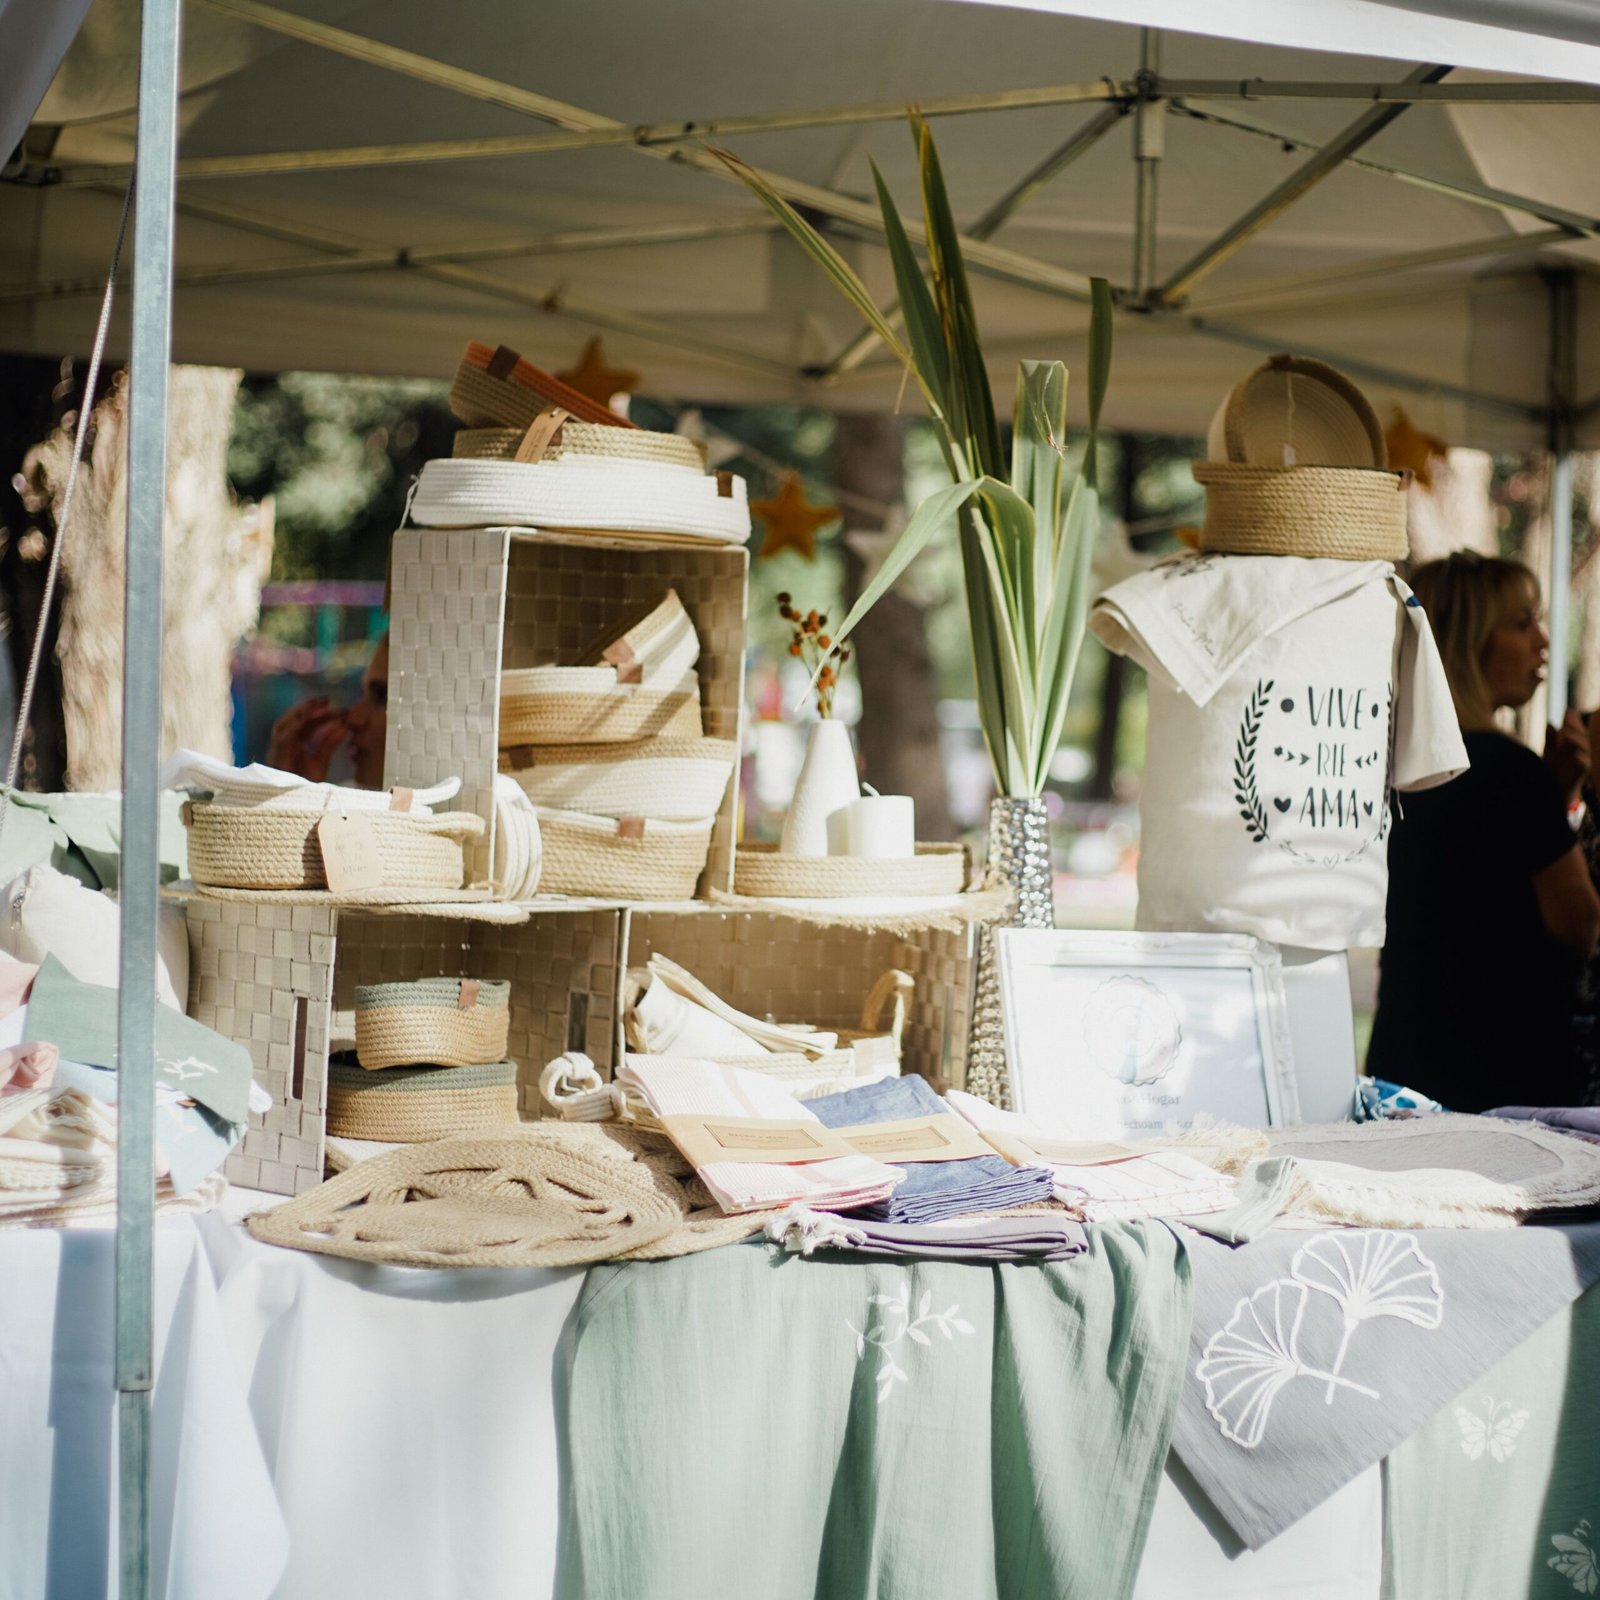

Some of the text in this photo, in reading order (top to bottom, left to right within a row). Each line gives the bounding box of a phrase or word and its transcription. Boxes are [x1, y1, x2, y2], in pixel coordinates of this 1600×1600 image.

[1308, 686, 1366, 730] VIVE
[1317, 742, 1347, 777] RIE
[1299, 787, 1359, 829] AMA
